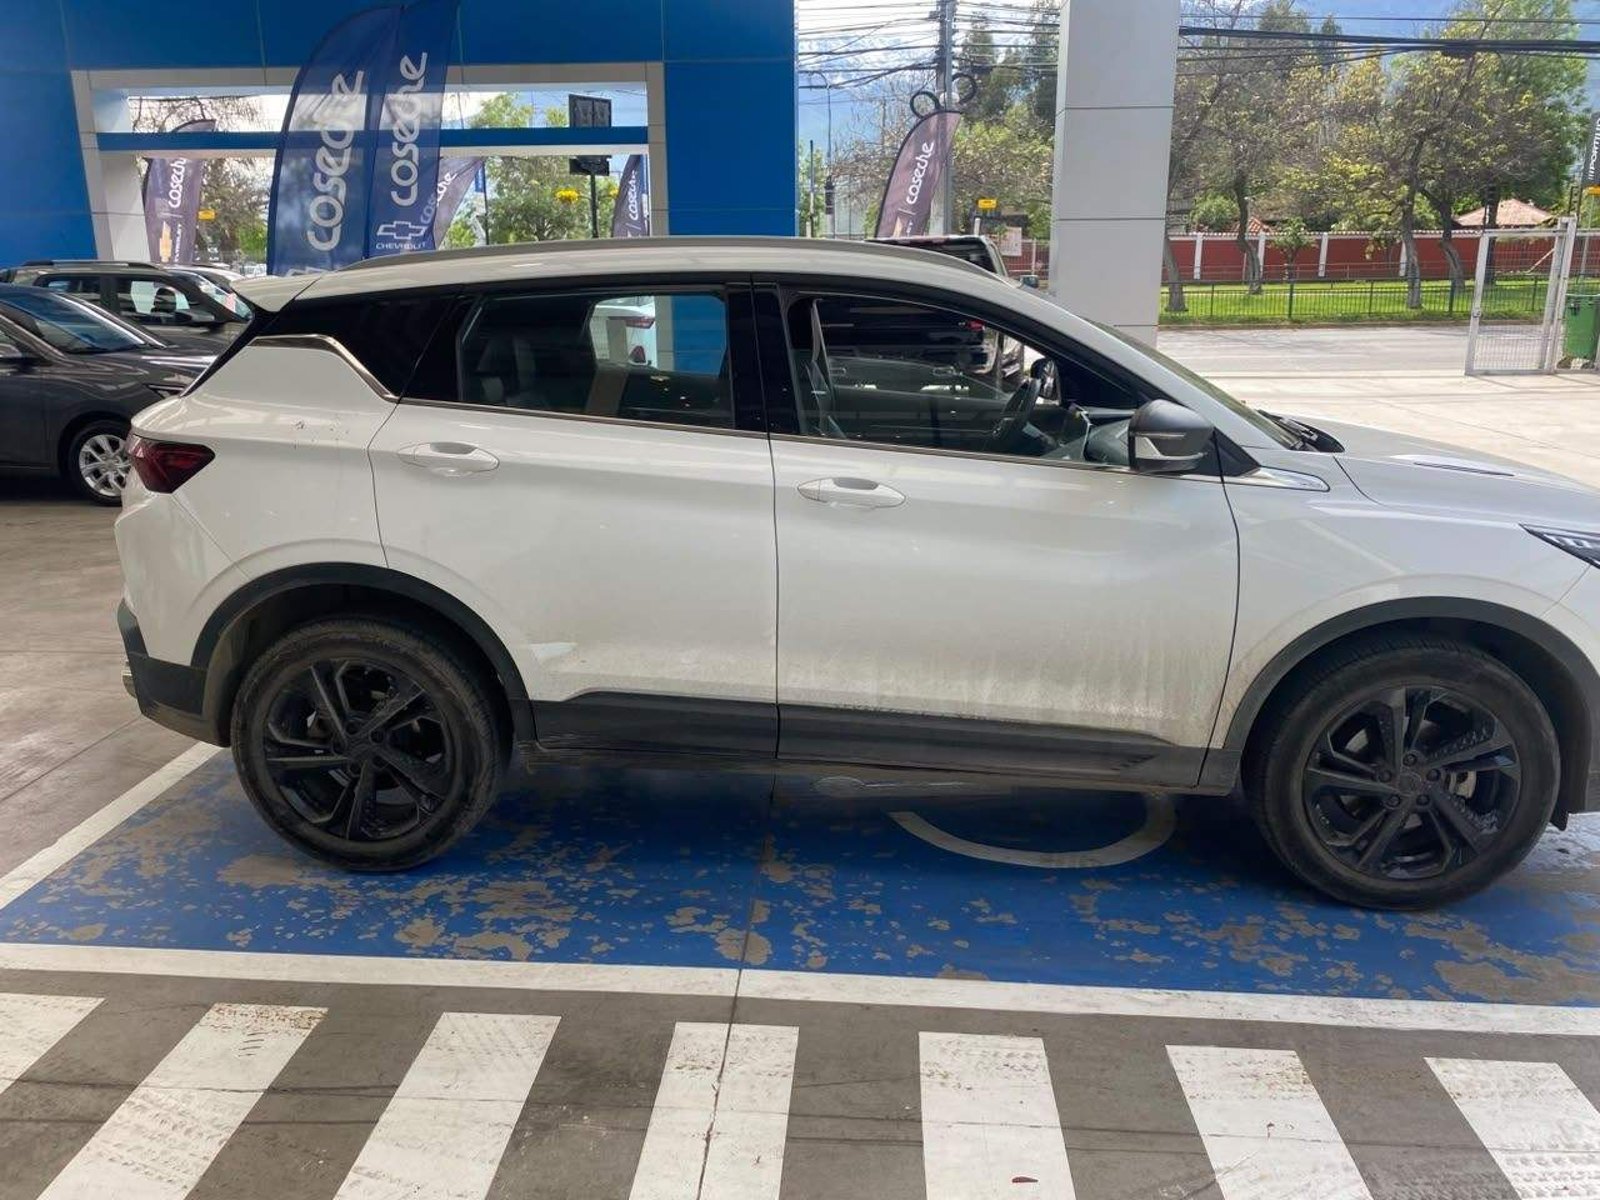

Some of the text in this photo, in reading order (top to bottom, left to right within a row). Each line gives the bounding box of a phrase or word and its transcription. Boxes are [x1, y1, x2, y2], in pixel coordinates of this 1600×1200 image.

[390, 51, 428, 207] coseche
[168, 157, 187, 208] cosech
[906, 141, 934, 205] coseche
